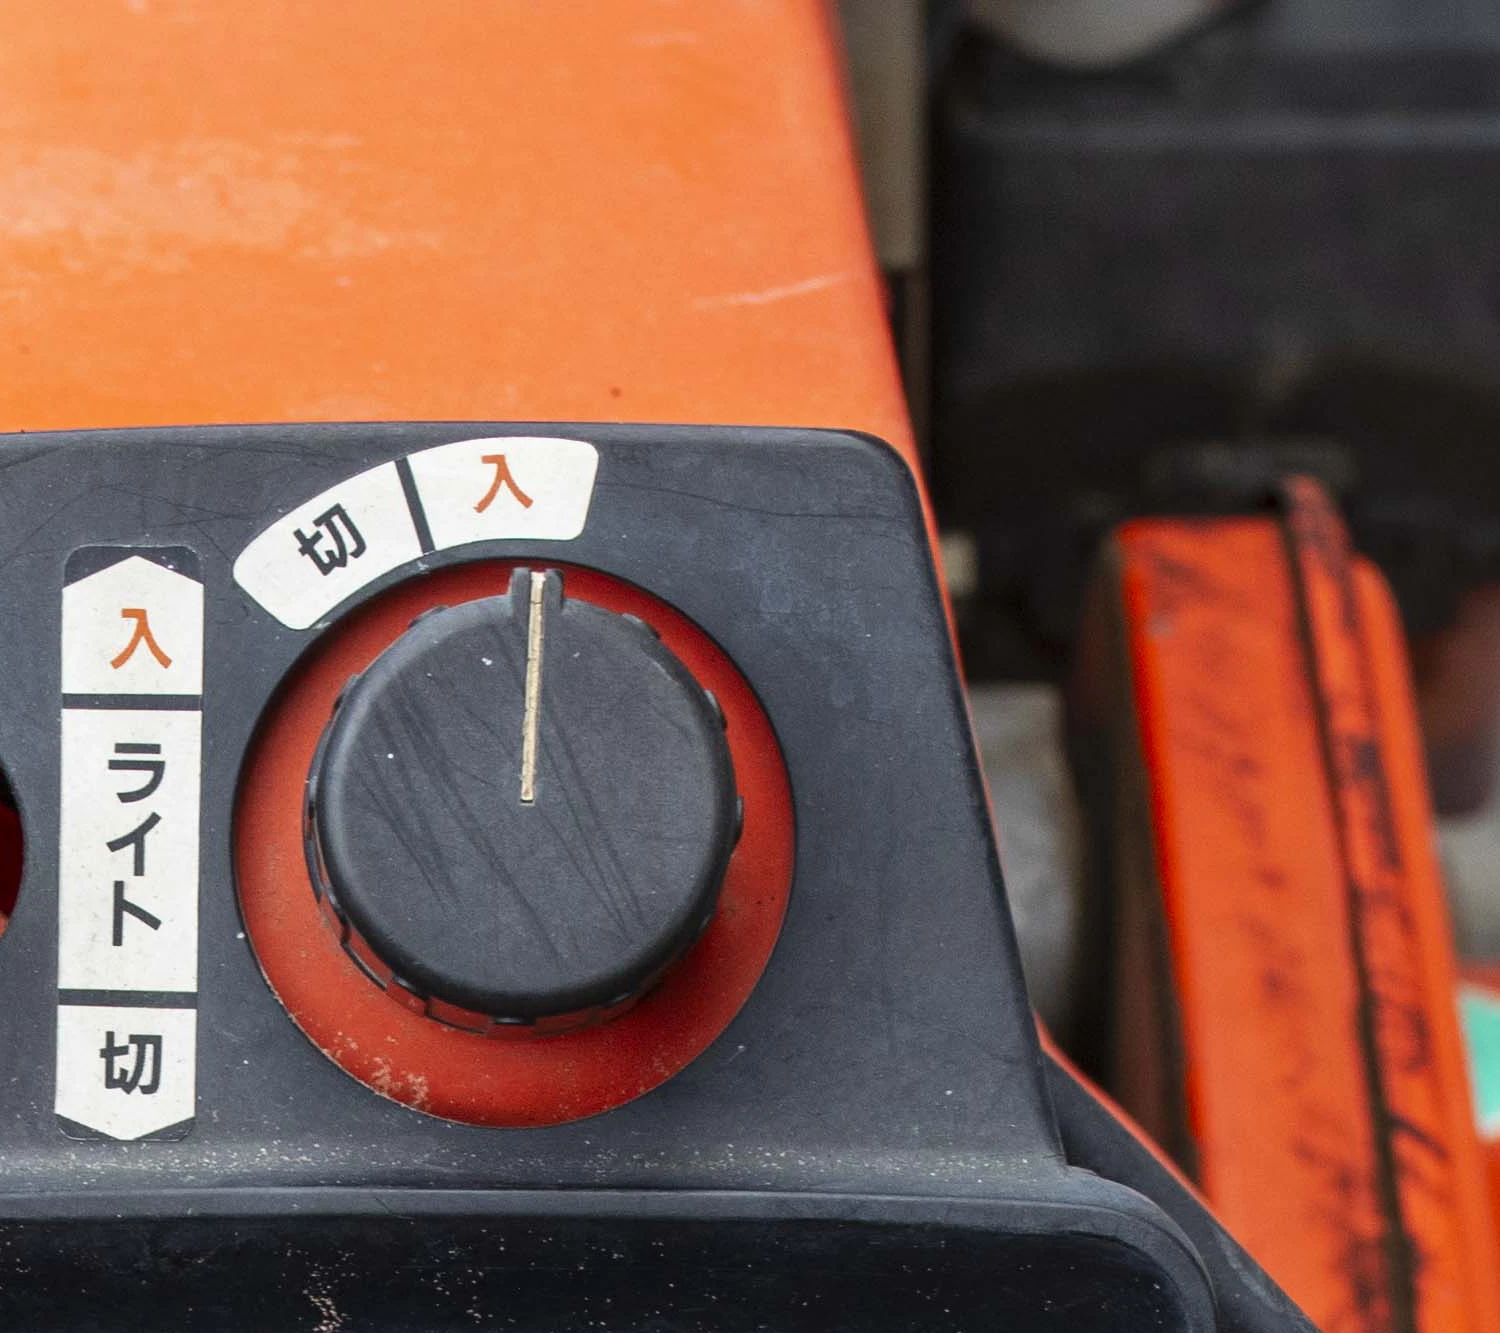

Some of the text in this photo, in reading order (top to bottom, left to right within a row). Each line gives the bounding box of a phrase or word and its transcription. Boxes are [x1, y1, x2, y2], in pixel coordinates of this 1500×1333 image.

[473, 454, 534, 513] 入
[294, 503, 366, 576] 切
[110, 608, 172, 669] 入
[107, 742, 166, 946] ライト
[100, 1030, 163, 1095] 切
